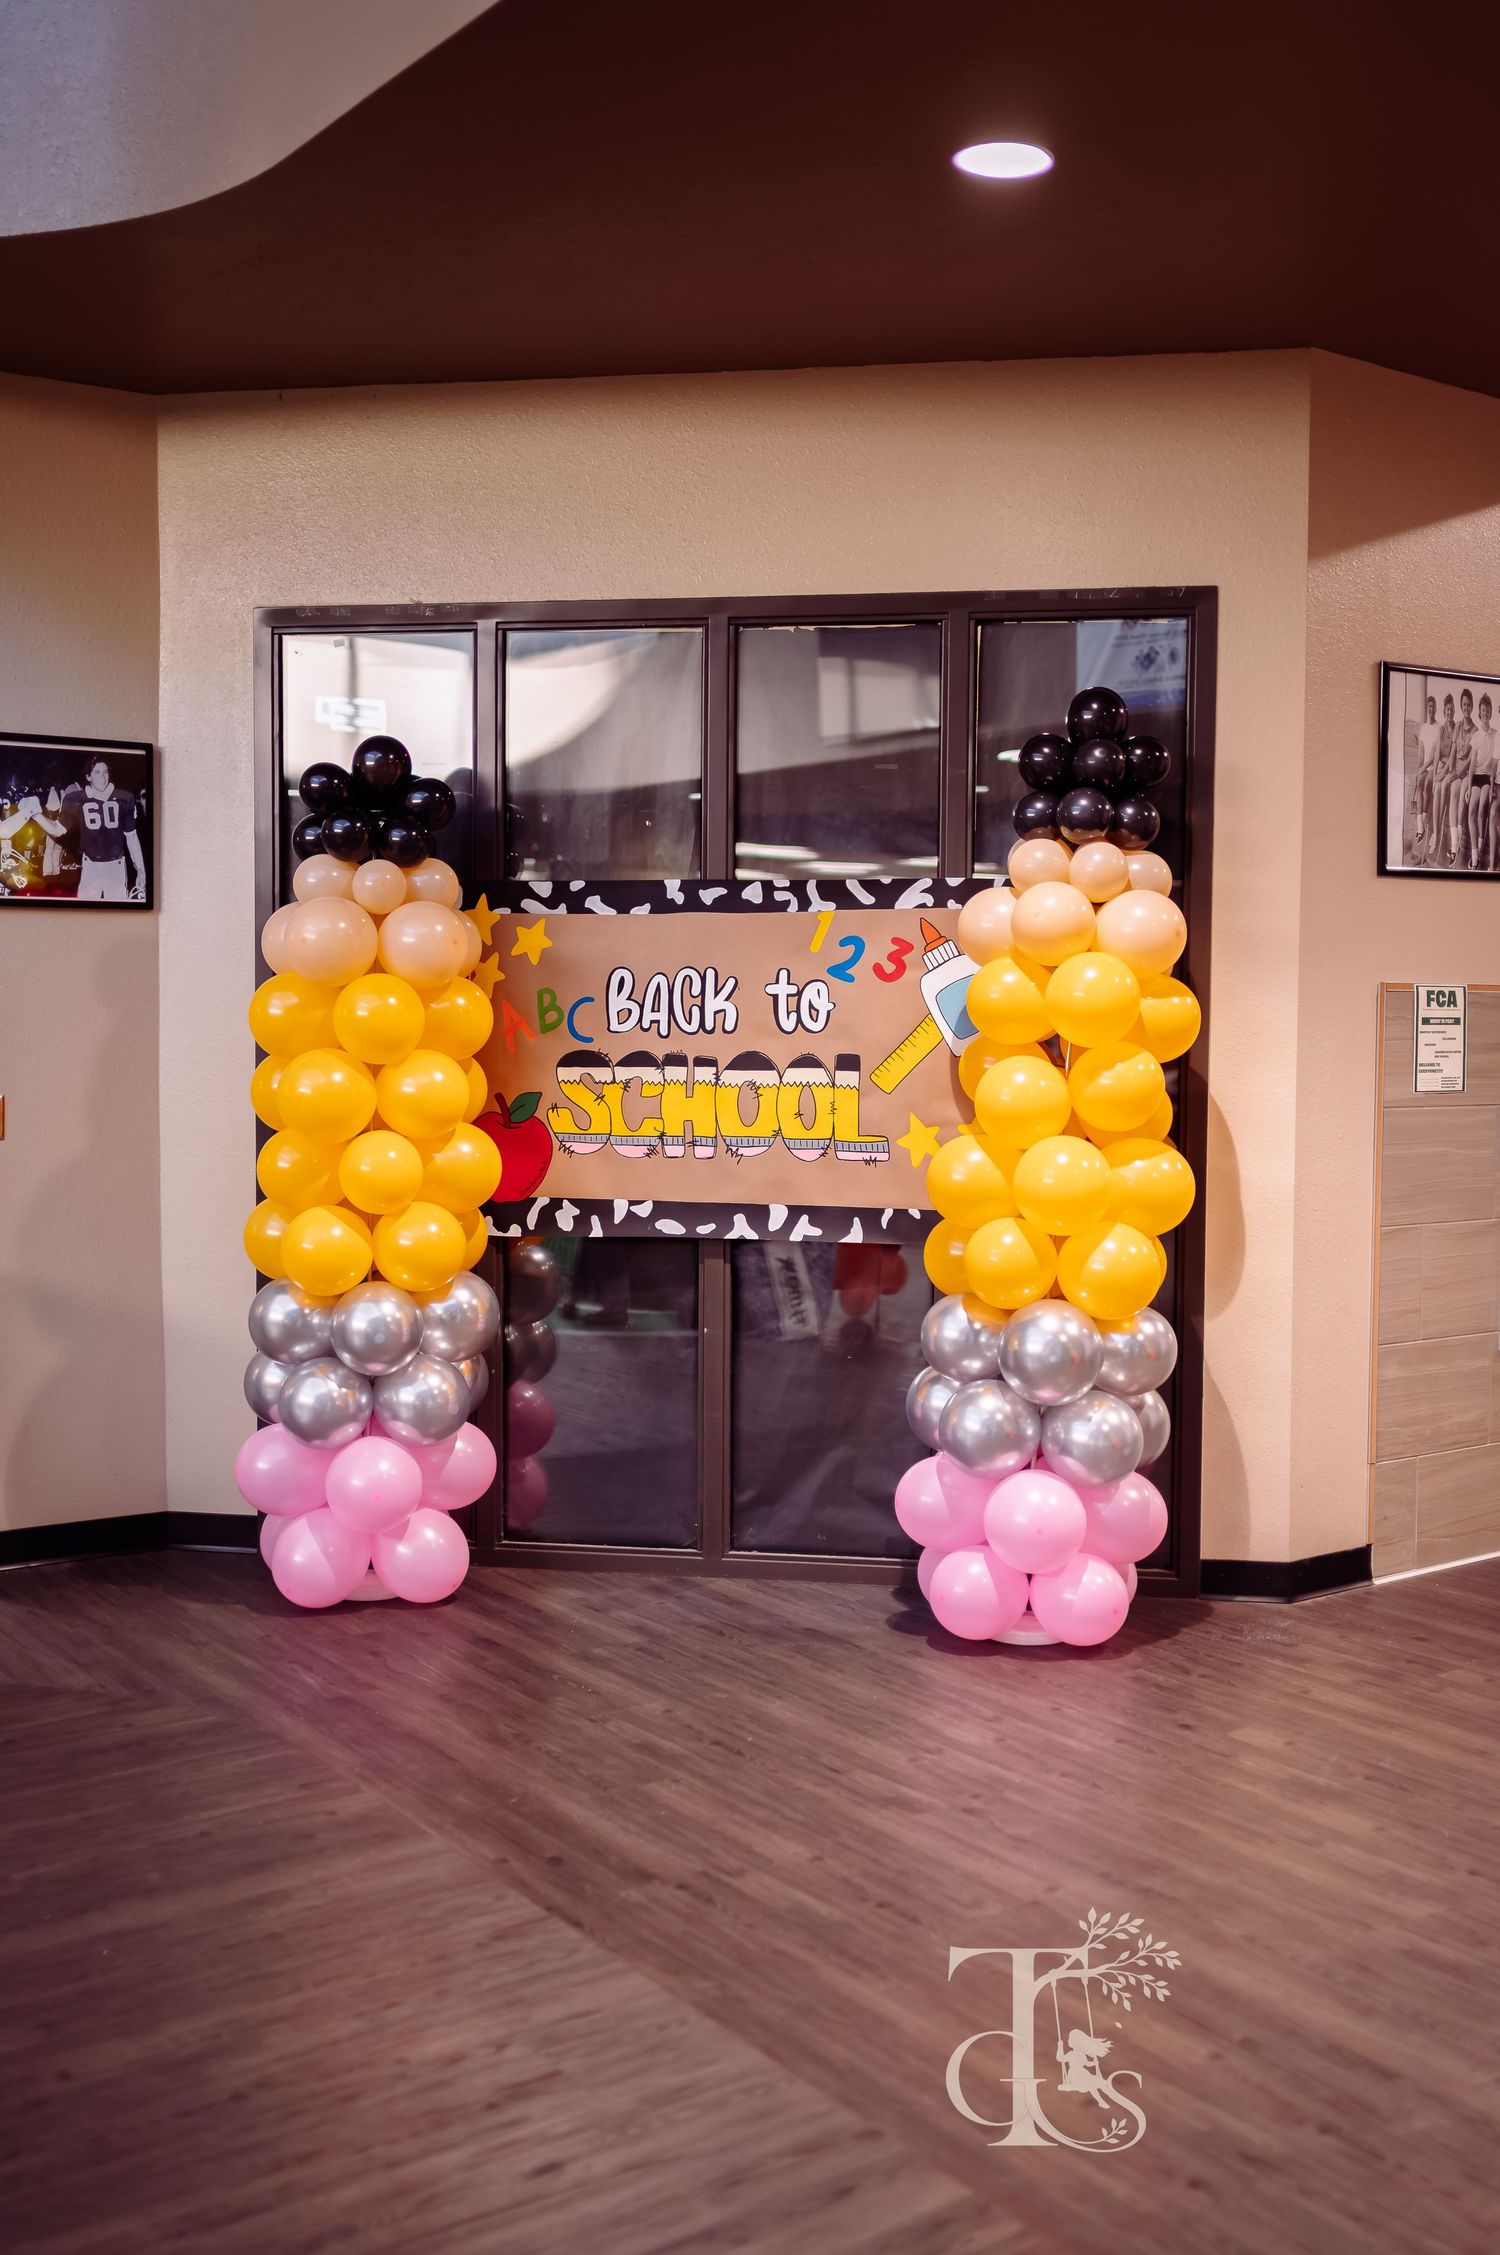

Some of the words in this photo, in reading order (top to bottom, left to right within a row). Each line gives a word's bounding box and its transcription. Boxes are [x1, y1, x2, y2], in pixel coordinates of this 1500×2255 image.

[82, 801, 119, 830] 60
[605, 965, 740, 1038] BACK
[764, 965, 836, 1035] to
[1426, 989, 1458, 1008] FCA
[546, 1049, 891, 1166] SCHOOL
